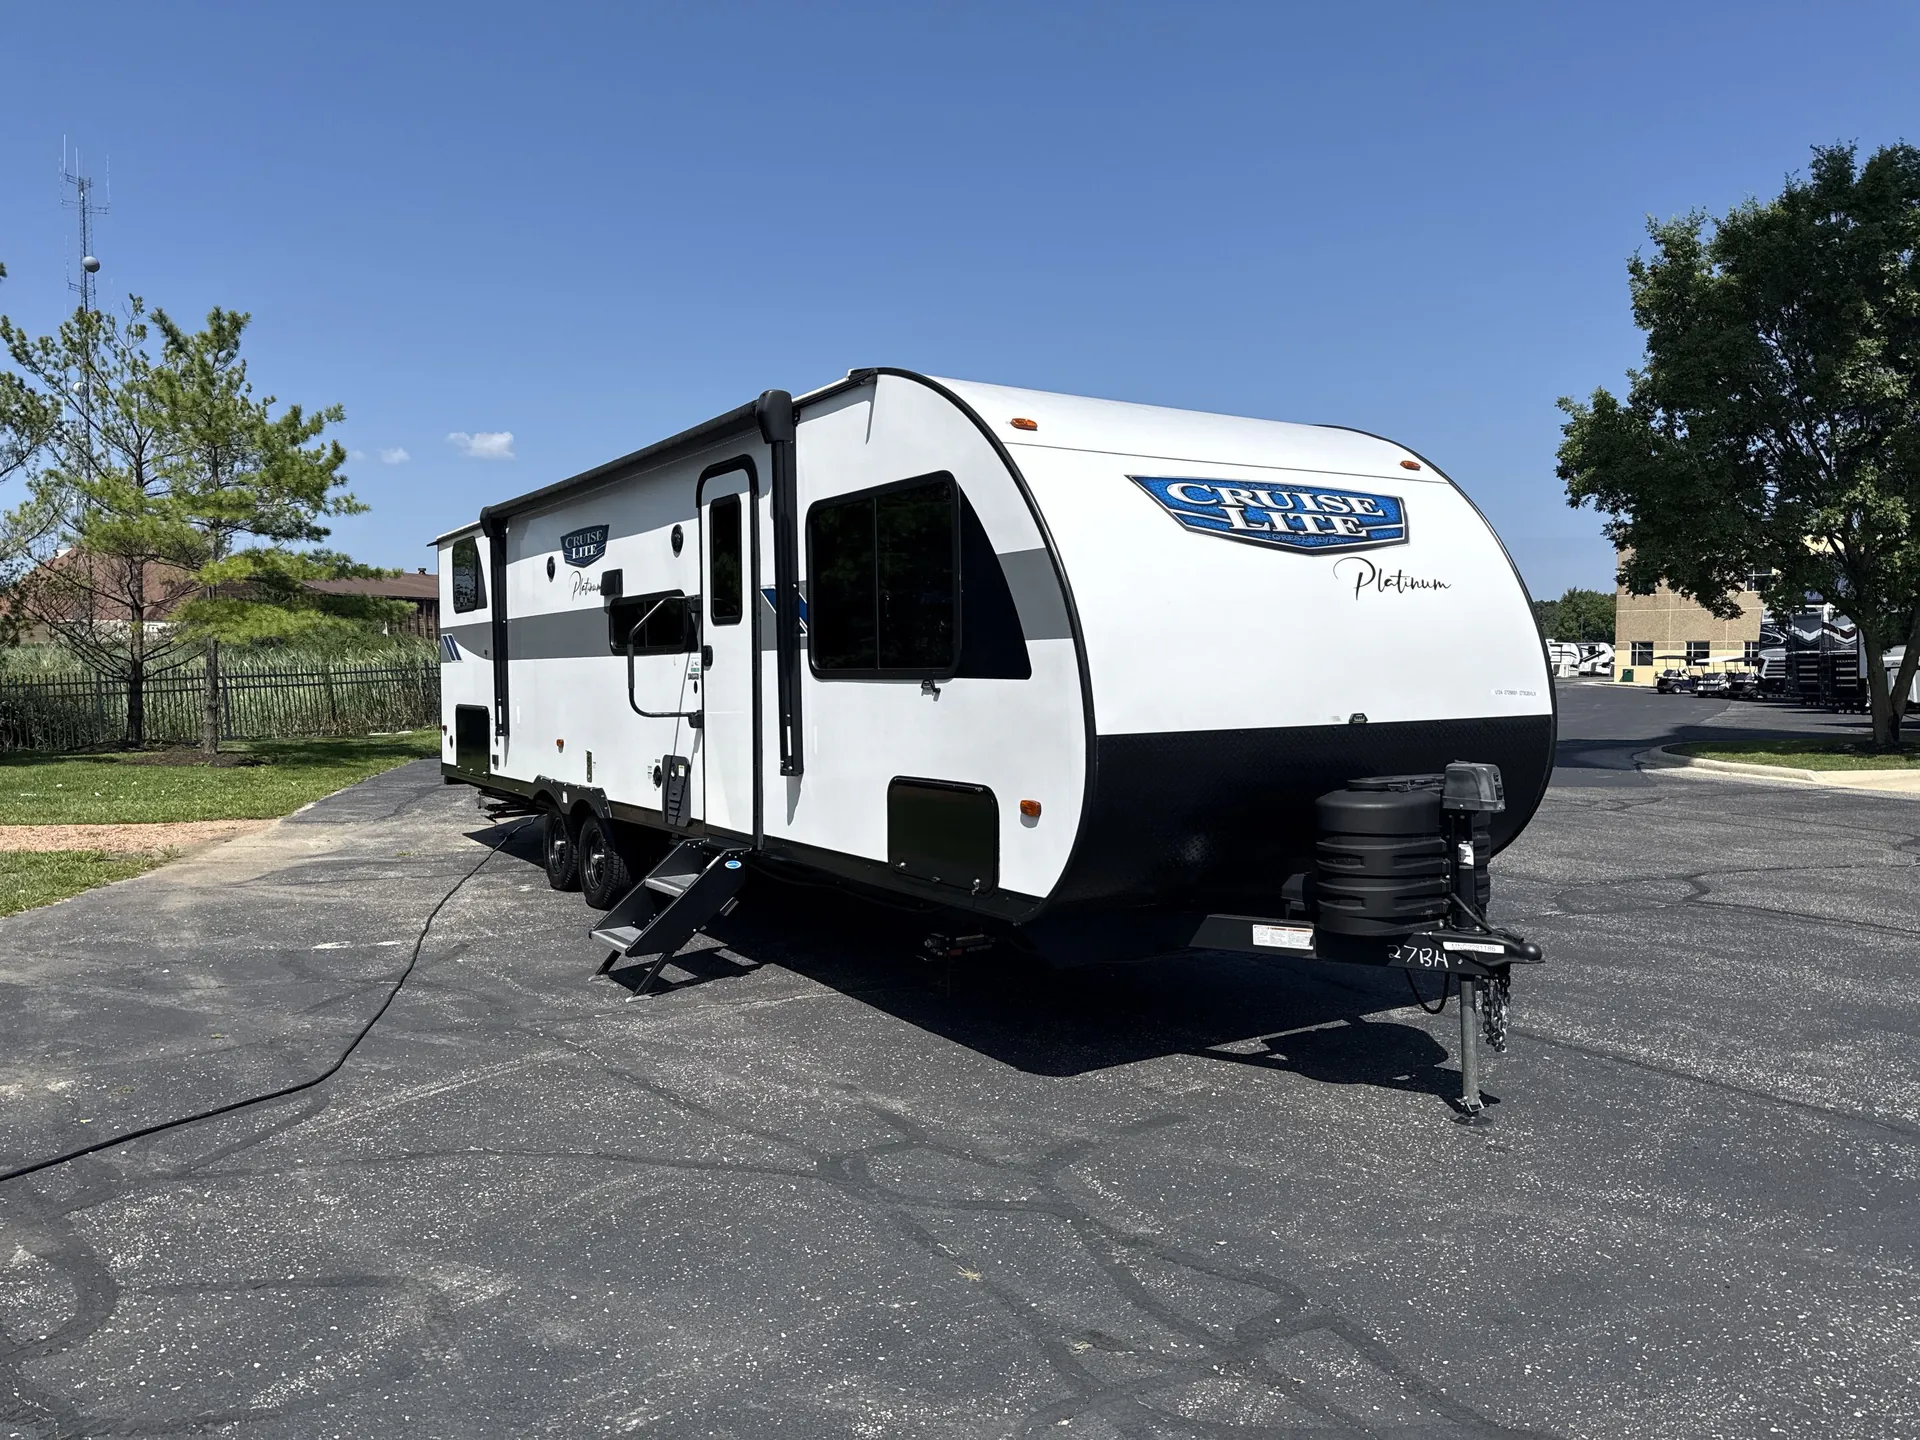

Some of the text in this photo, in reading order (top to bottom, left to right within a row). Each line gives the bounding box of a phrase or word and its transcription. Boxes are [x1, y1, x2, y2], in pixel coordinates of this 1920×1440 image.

[1166, 482, 1385, 517] CRUISE
[1218, 506, 1368, 538] LITE
[565, 529, 604, 549] CRUISE
[572, 543, 598, 559] LITE
[1333, 556, 1452, 602] Platinum
